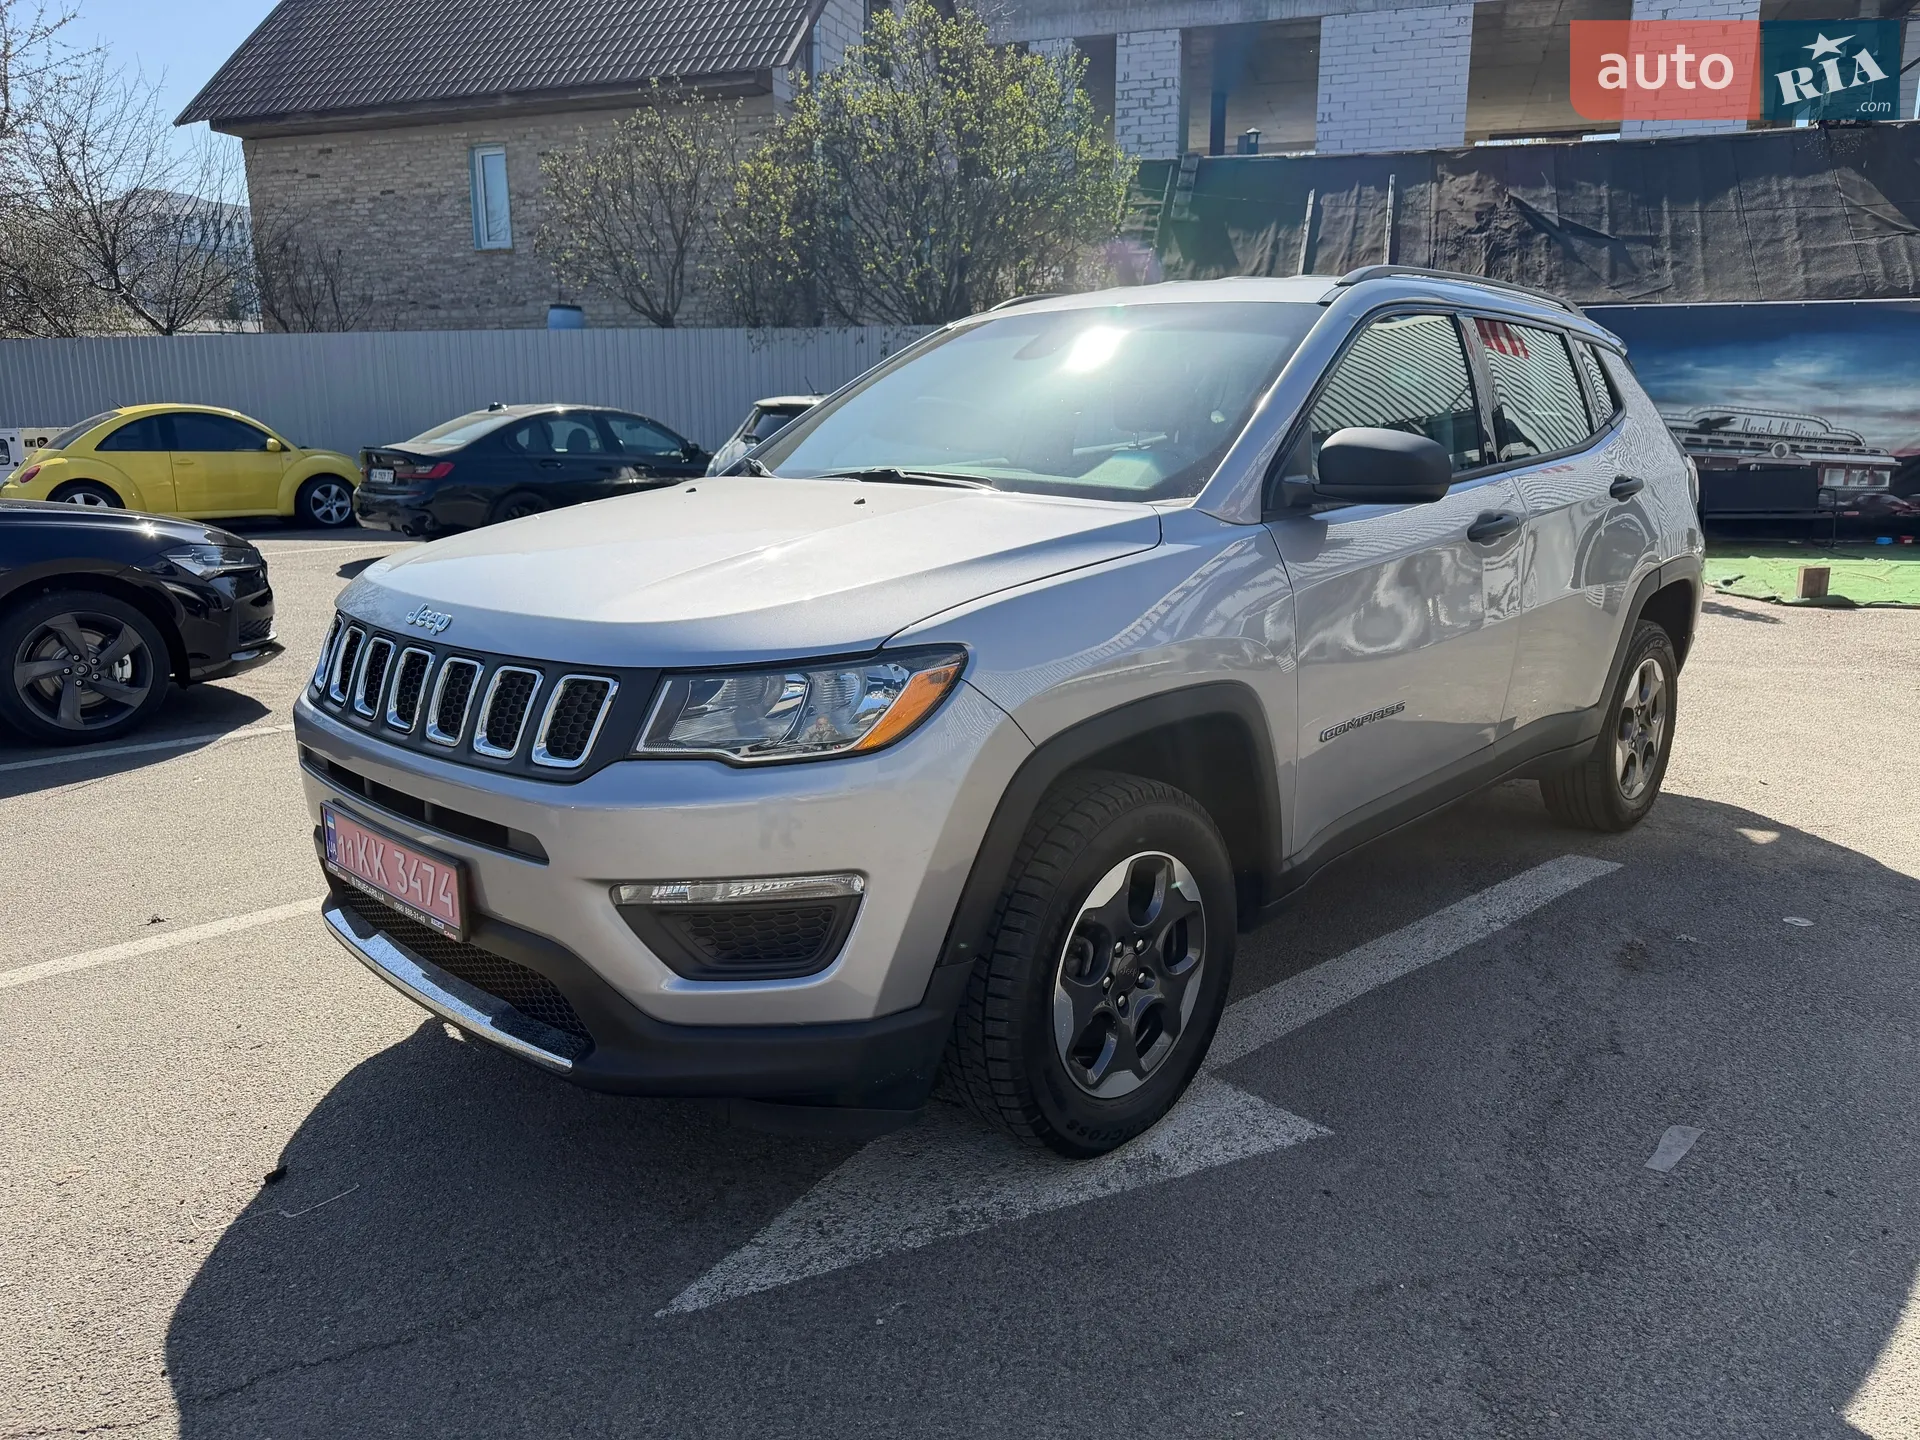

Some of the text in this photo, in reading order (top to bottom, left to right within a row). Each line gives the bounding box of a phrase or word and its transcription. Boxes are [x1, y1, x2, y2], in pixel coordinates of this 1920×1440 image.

[405, 603, 452, 636] Jeep
[1320, 700, 1406, 742] COMPASS
[394, 849, 455, 918] 3474
